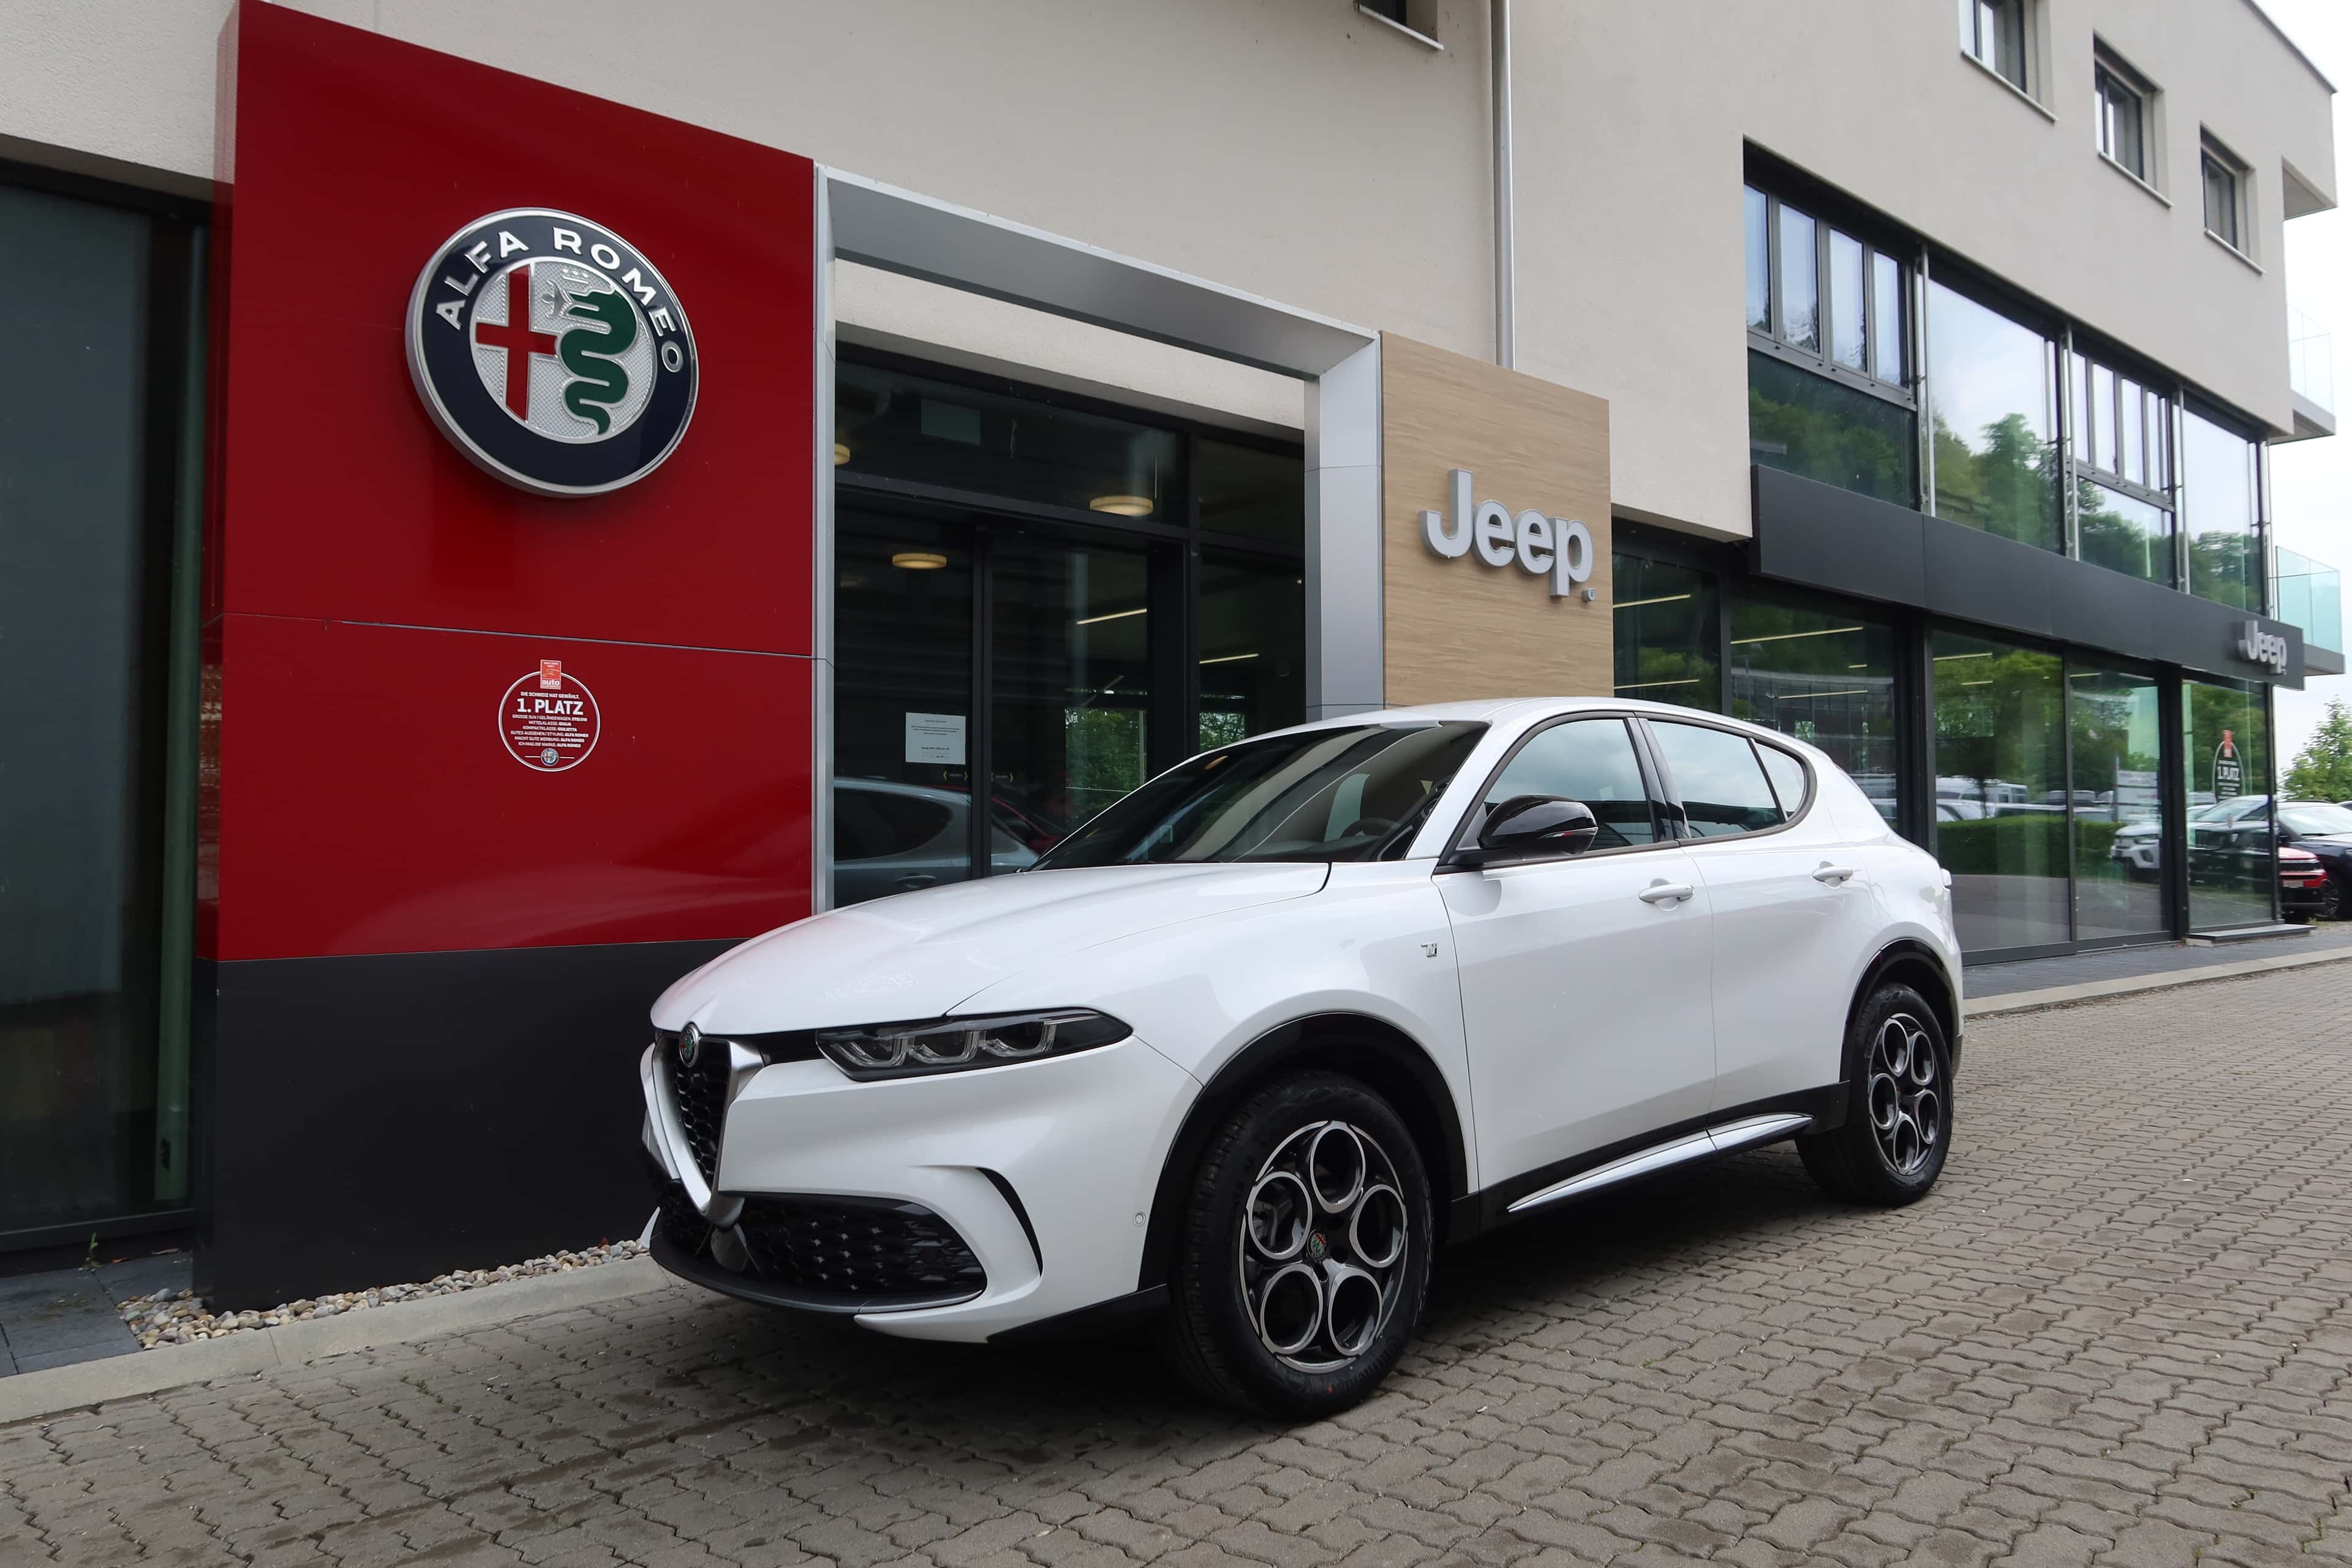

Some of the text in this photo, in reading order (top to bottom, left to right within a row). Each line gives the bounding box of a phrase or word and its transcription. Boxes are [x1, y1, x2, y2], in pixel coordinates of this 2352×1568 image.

[436, 226, 684, 373] ALFA ROMEO
[1419, 468, 1594, 598] Jeep
[2237, 619, 2287, 674] Jeep
[517, 698, 583, 715] 1. PLATZ
